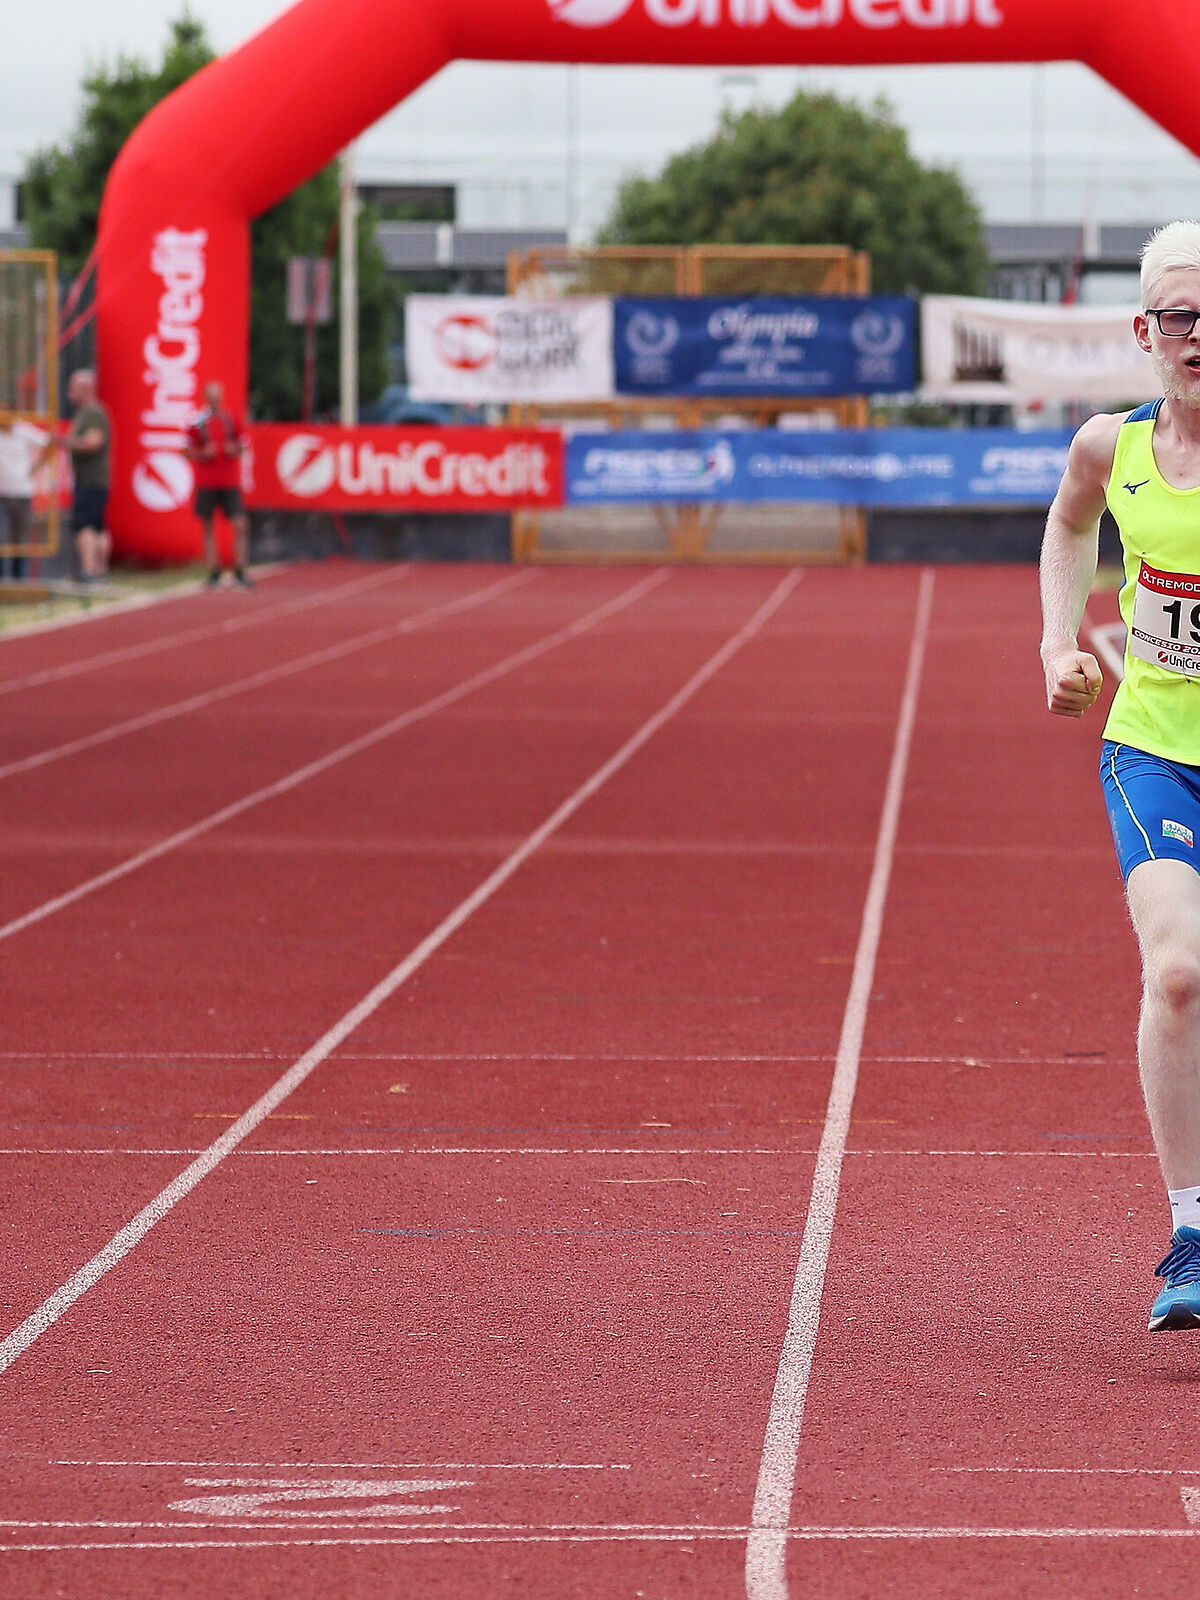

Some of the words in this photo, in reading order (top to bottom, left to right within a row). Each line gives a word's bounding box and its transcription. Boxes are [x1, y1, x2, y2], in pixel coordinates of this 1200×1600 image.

[139, 226, 207, 450] UniCredit
[338, 440, 549, 495] UniCredit
[1134, 629, 1181, 651] CONCESIO
